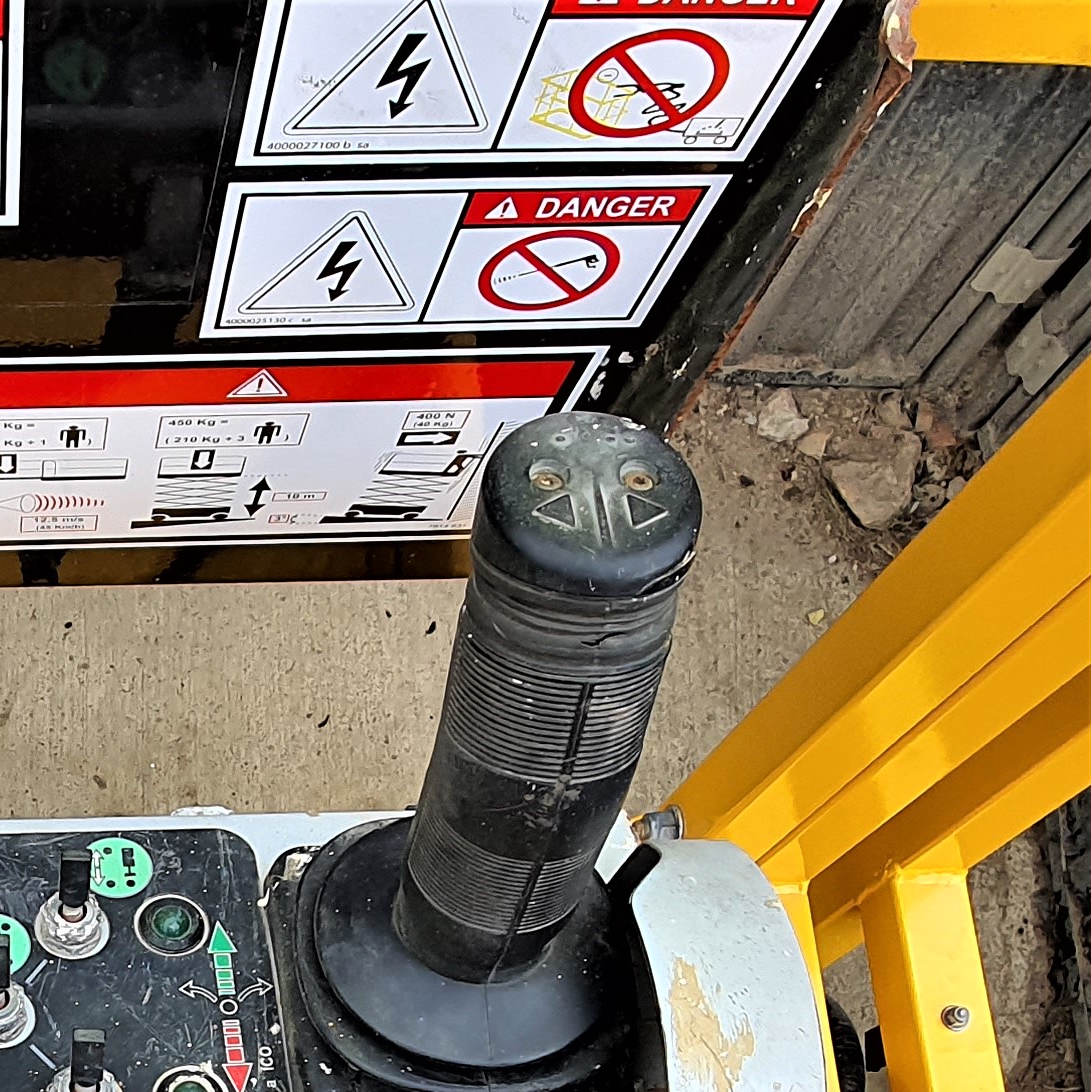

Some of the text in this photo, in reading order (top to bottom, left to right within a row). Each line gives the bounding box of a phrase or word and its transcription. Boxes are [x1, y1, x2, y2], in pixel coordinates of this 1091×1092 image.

[267, 140, 340, 150] 4000027100
[535, 195, 677, 219] DANGER
[4, 422, 23, 431] Kg
[168, 418, 192, 426] 450
[197, 418, 216, 427] Kg
[4, 439, 23, 448] Kg
[202, 436, 220, 444] Kg
